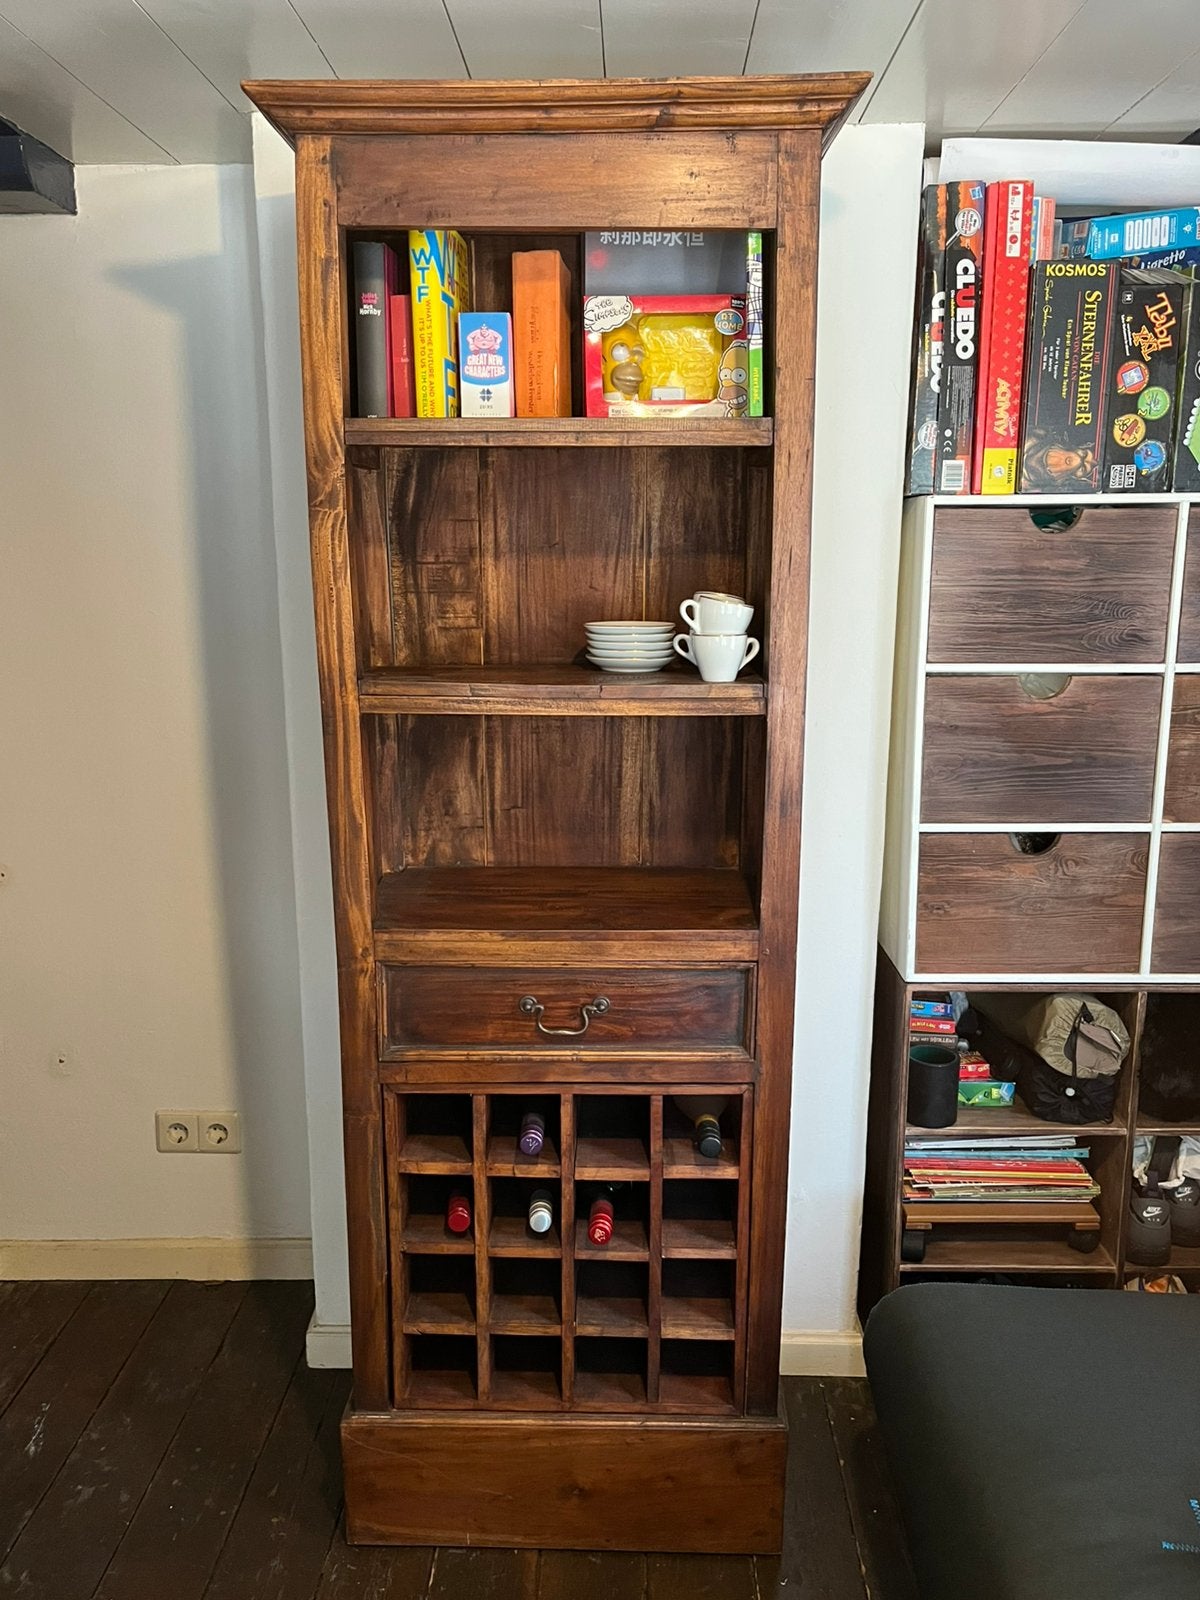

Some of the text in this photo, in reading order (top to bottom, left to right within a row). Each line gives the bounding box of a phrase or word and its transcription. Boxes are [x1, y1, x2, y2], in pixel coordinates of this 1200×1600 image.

[411, 248, 431, 303] WTF
[1045, 263, 1107, 277] KOSMOS
[359, 308, 382, 316] Hornby
[425, 299, 433, 330] WHAT'S
[955, 258, 976, 360] CLUEDO
[717, 321, 742, 331] HOME
[1144, 292, 1176, 351] Tabu
[419, 333, 426, 344] UP
[930, 291, 946, 394] CLUEDO
[420, 346, 426, 356] TO
[467, 354, 503, 365] GREAT NEW
[1075, 289, 1102, 426] STERNENFAHRER
[420, 358, 427, 369] US
[464, 365, 506, 378] CHARACTERS
[1071, 354, 1079, 381] CATAN
[1061, 379, 1069, 399] Teuber
[993, 378, 1012, 436] ACTIVITY
[1006, 458, 1014, 484] Piatnik
